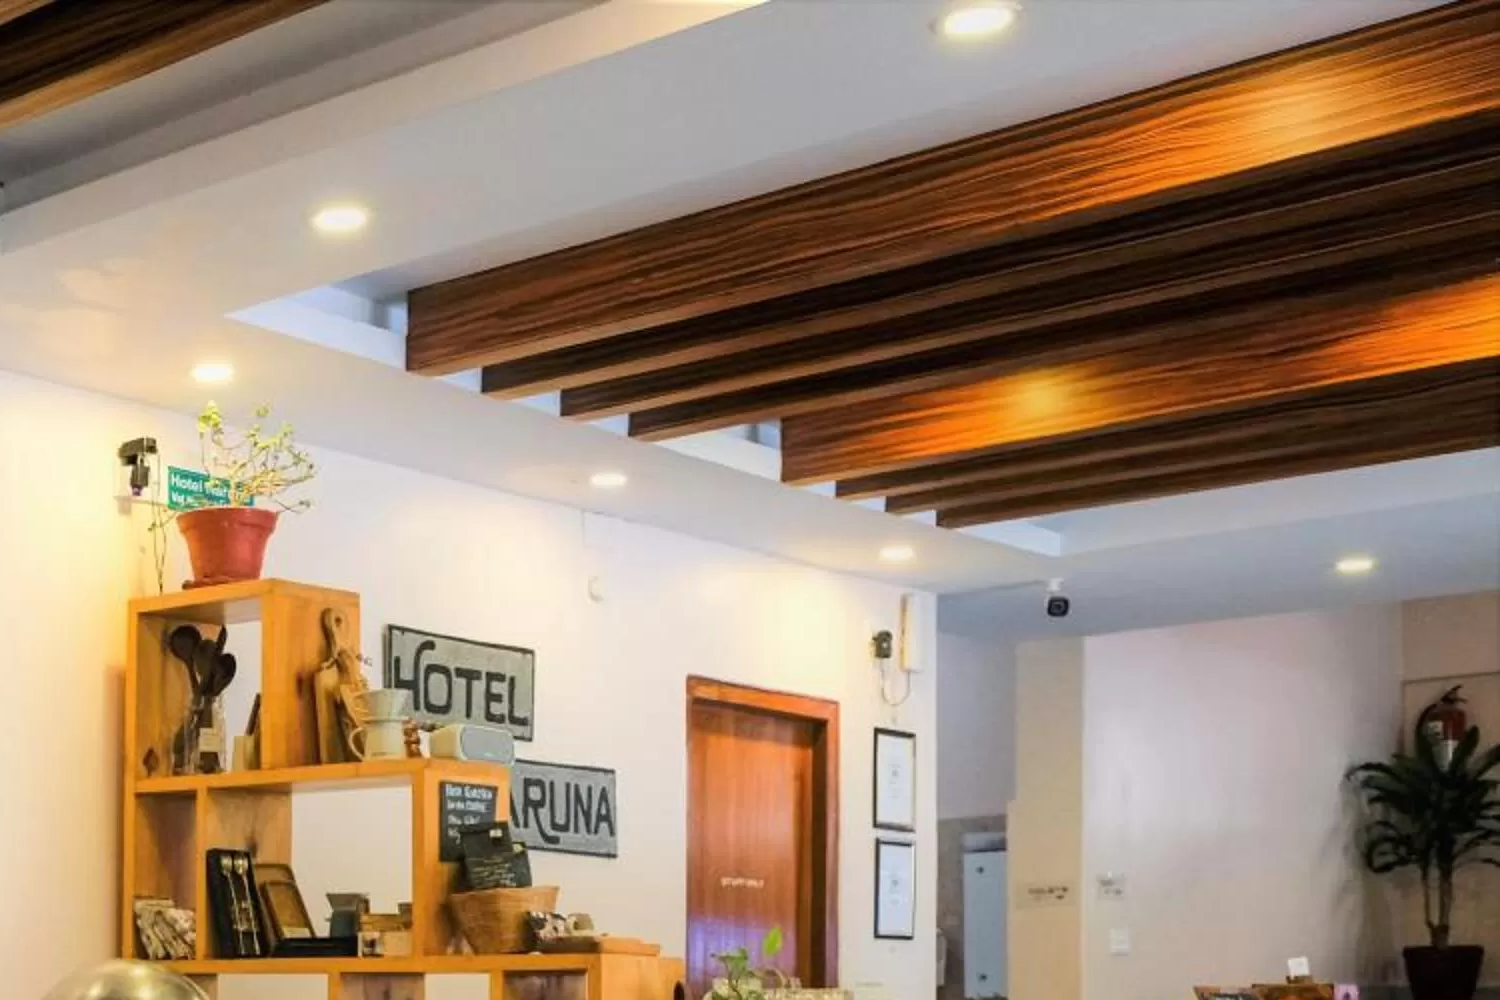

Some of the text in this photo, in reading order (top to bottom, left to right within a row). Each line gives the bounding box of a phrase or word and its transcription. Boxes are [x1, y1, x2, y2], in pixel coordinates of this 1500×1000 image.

[171, 473, 203, 493] Hotel
[394, 640, 529, 726] HOTEL
[510, 778, 615, 844] RUNA
